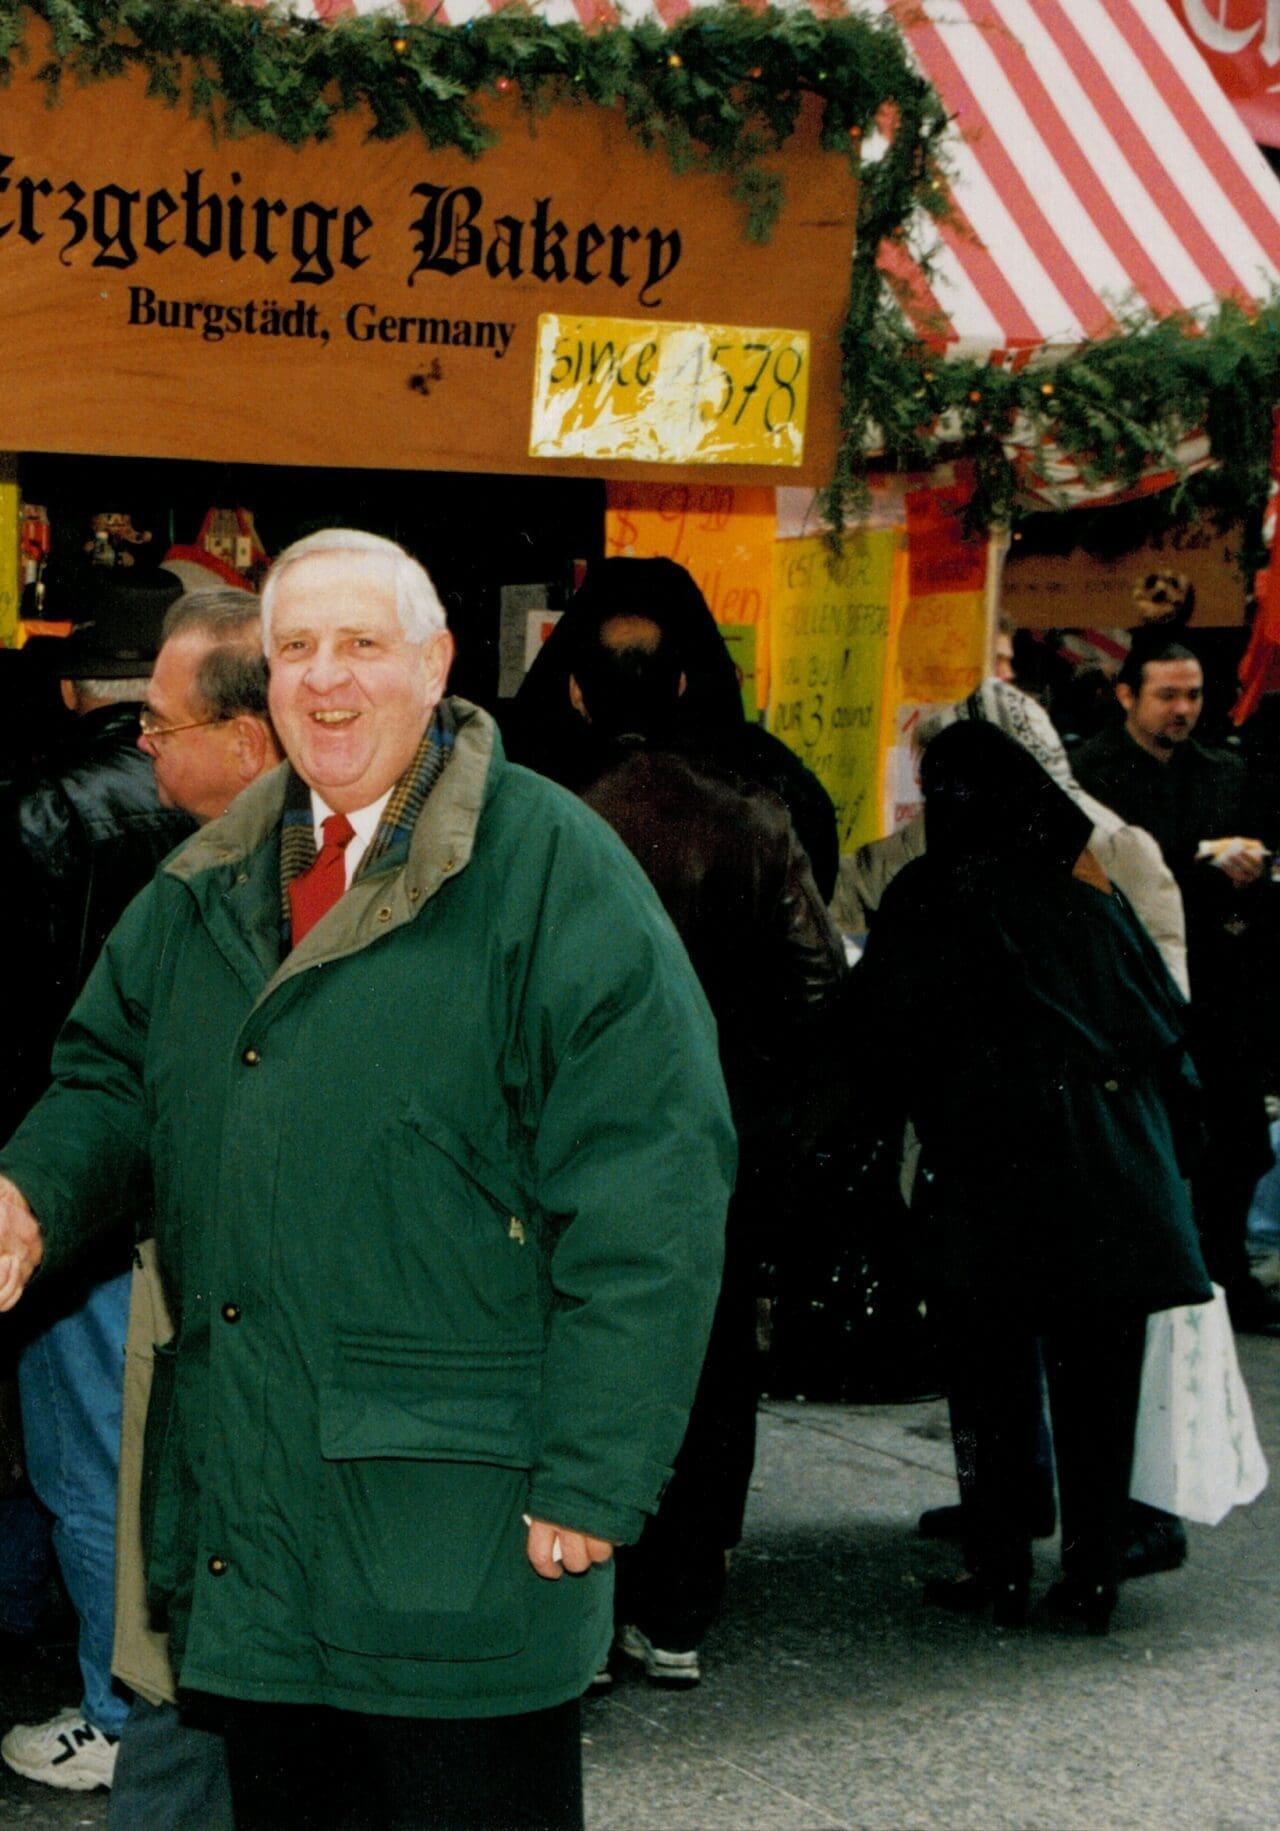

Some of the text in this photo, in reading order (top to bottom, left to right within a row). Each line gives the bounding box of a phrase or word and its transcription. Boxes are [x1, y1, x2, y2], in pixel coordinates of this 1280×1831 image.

[407, 182, 682, 307] Bakery
[128, 286, 515, 358] Burgstädt, Germany
[671, 343, 802, 434] 1578
